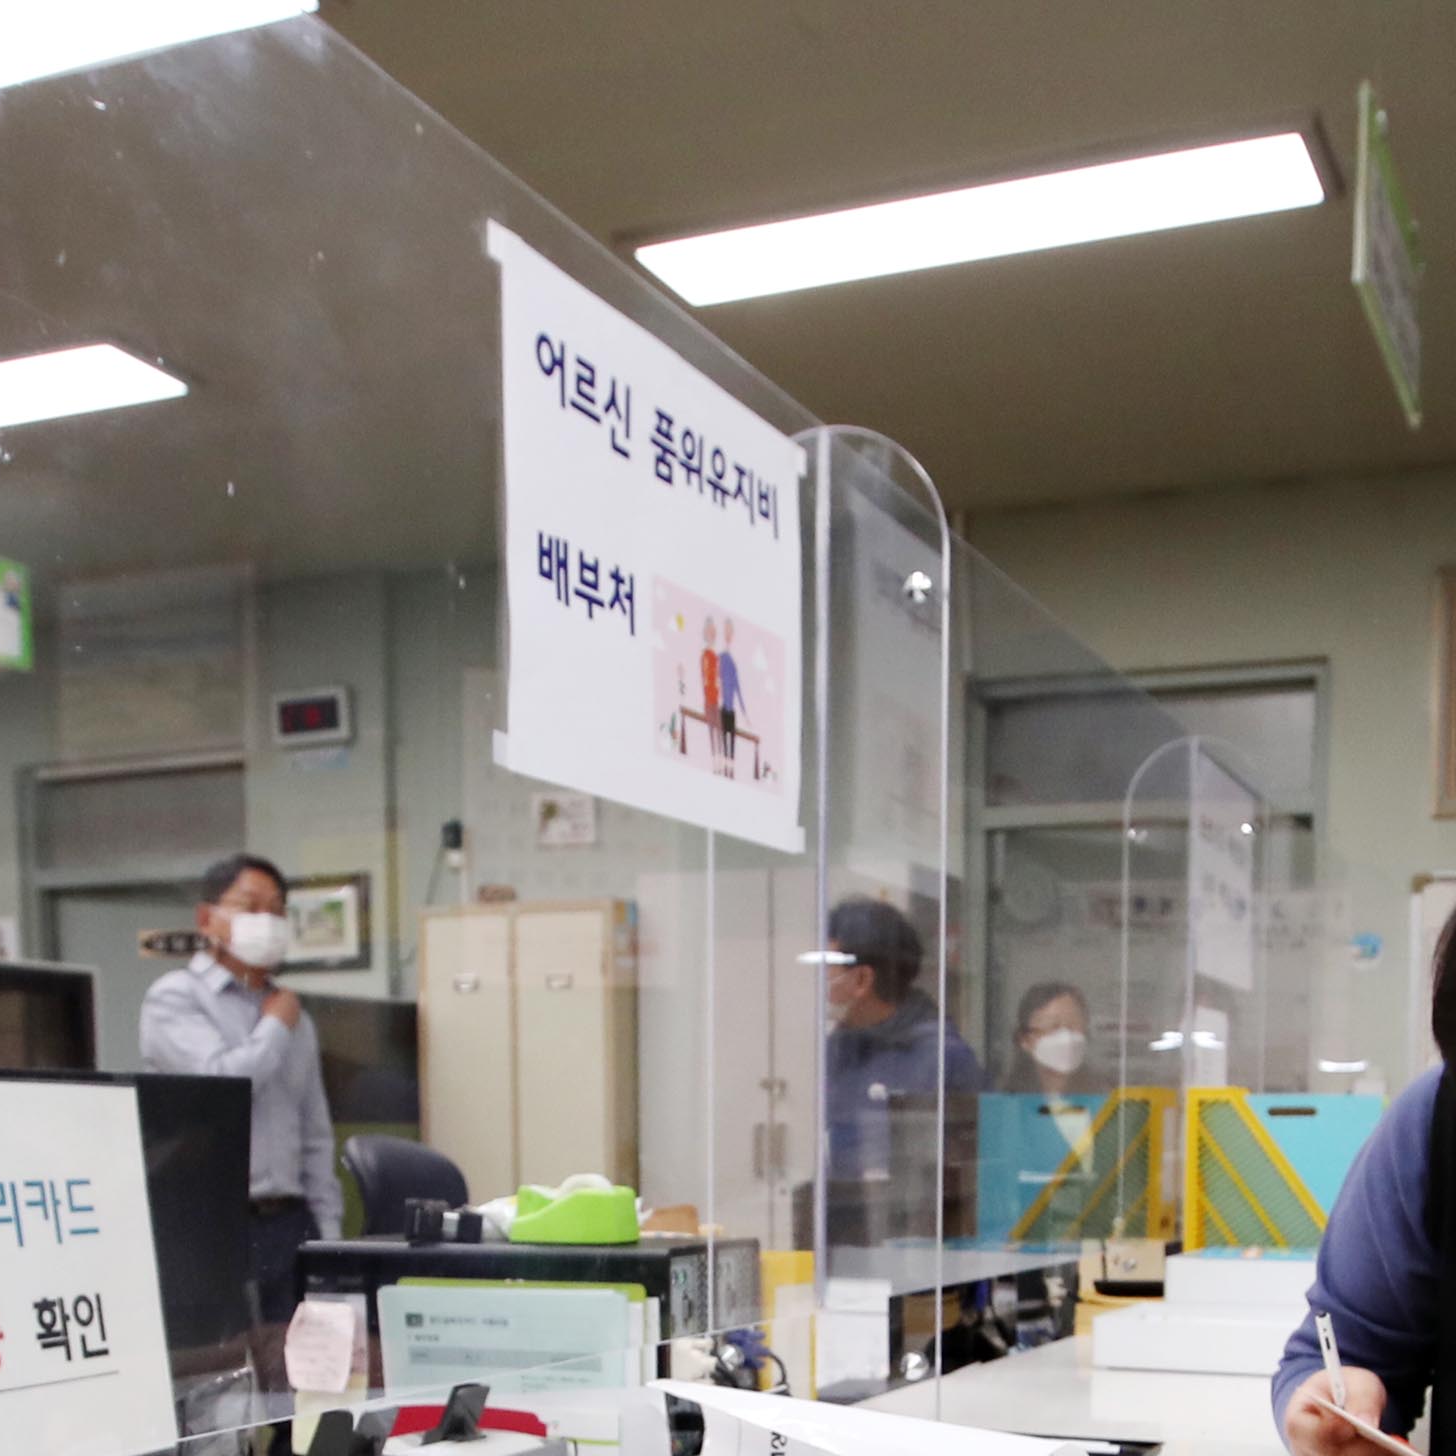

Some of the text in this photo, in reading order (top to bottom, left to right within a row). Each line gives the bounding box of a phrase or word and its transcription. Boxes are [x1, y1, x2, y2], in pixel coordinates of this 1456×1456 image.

[535, 331, 780, 541] 어르신 품위유지비
[537, 530, 636, 638] 배부처
[32, 1294, 110, 1362] 확인
